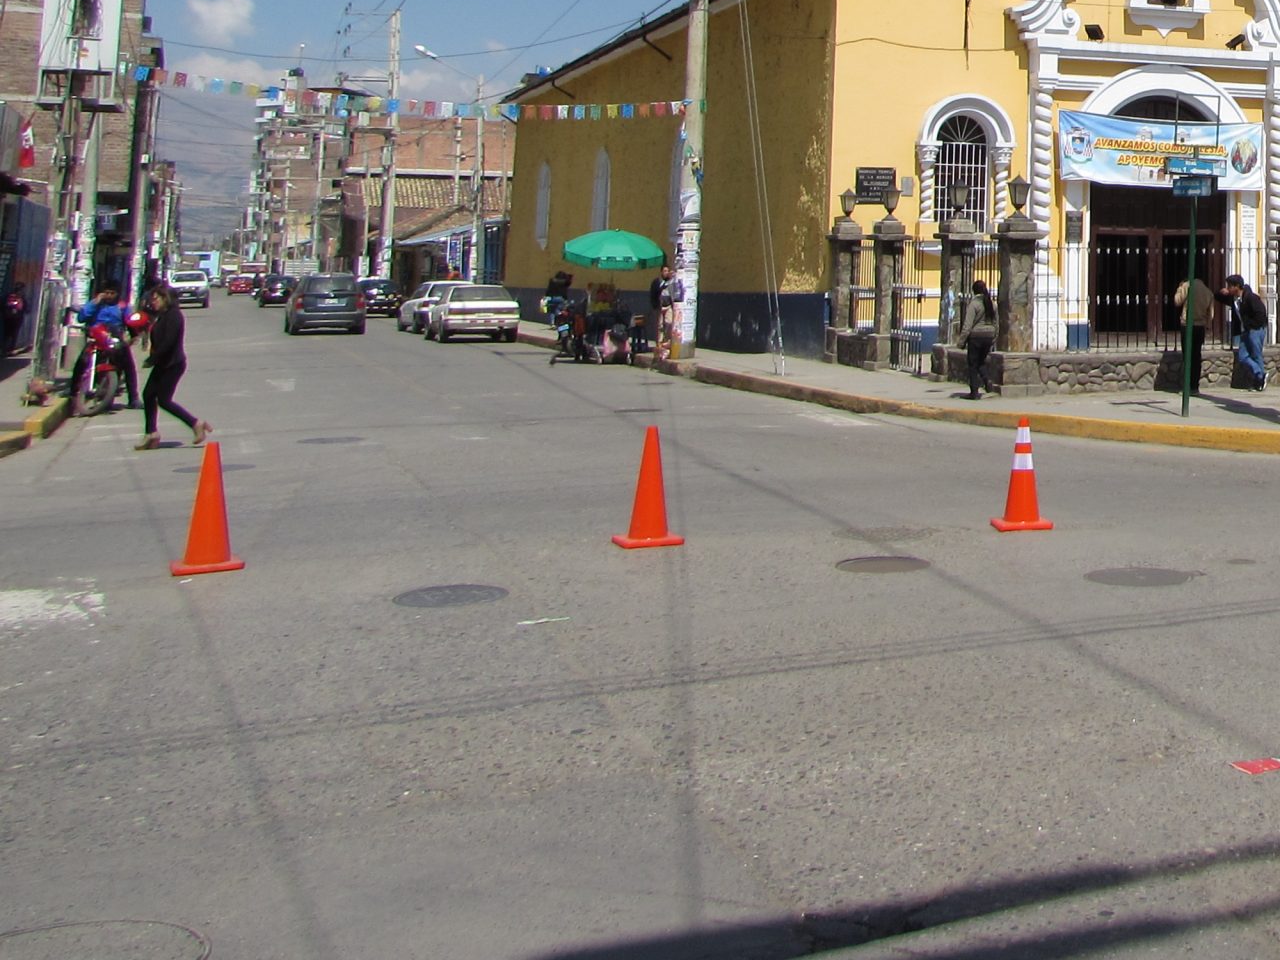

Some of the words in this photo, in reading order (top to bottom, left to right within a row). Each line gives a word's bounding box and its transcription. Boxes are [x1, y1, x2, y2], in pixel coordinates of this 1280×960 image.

[1093, 136, 1155, 152] AVANZAMOS
[1157, 141, 1188, 154] COMO
[1117, 154, 1165, 166] APOYEMO
